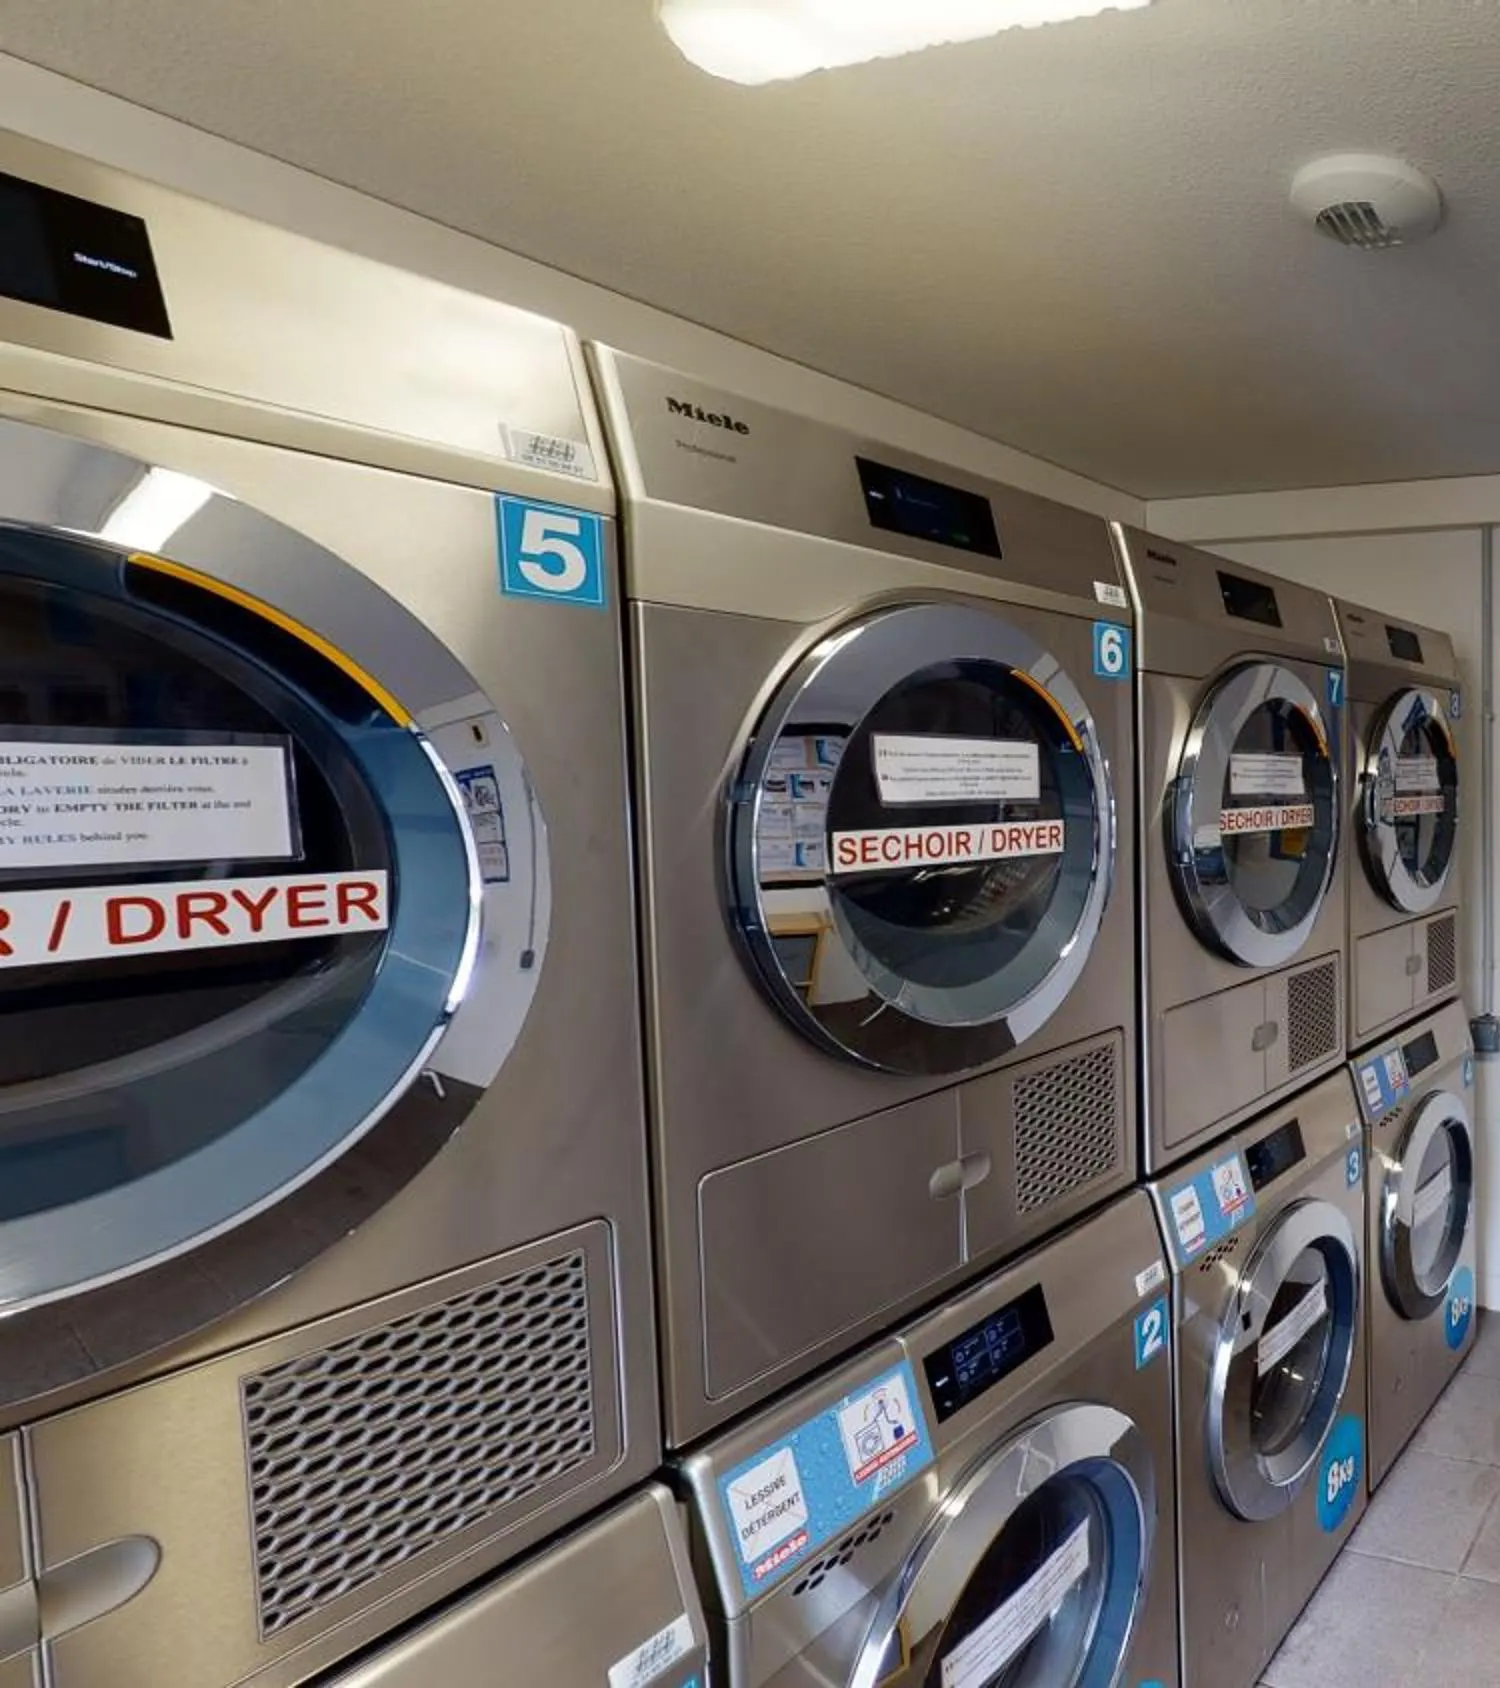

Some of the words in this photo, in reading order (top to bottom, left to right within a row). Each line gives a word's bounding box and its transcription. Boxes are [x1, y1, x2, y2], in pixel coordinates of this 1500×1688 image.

[665, 397, 750, 435] Miele
[517, 512, 588, 594] 5
[1100, 628, 1123, 673] 6
[1329, 671, 1341, 703] 7
[54, 803, 108, 813] EMPTY
[113, 802, 144, 812] THE
[147, 801, 198, 811] FILTER
[22, 833, 77, 844] RULES
[80, 831, 122, 842] behind
[838, 831, 972, 866] SECHOIR
[991, 825, 1061, 853] DRYER
[105, 881, 380, 946] DRYER
[1348, 1150, 1360, 1183] 3
[1141, 1309, 1162, 1361] 2
[744, 1474, 786, 1511] LESSIVE
